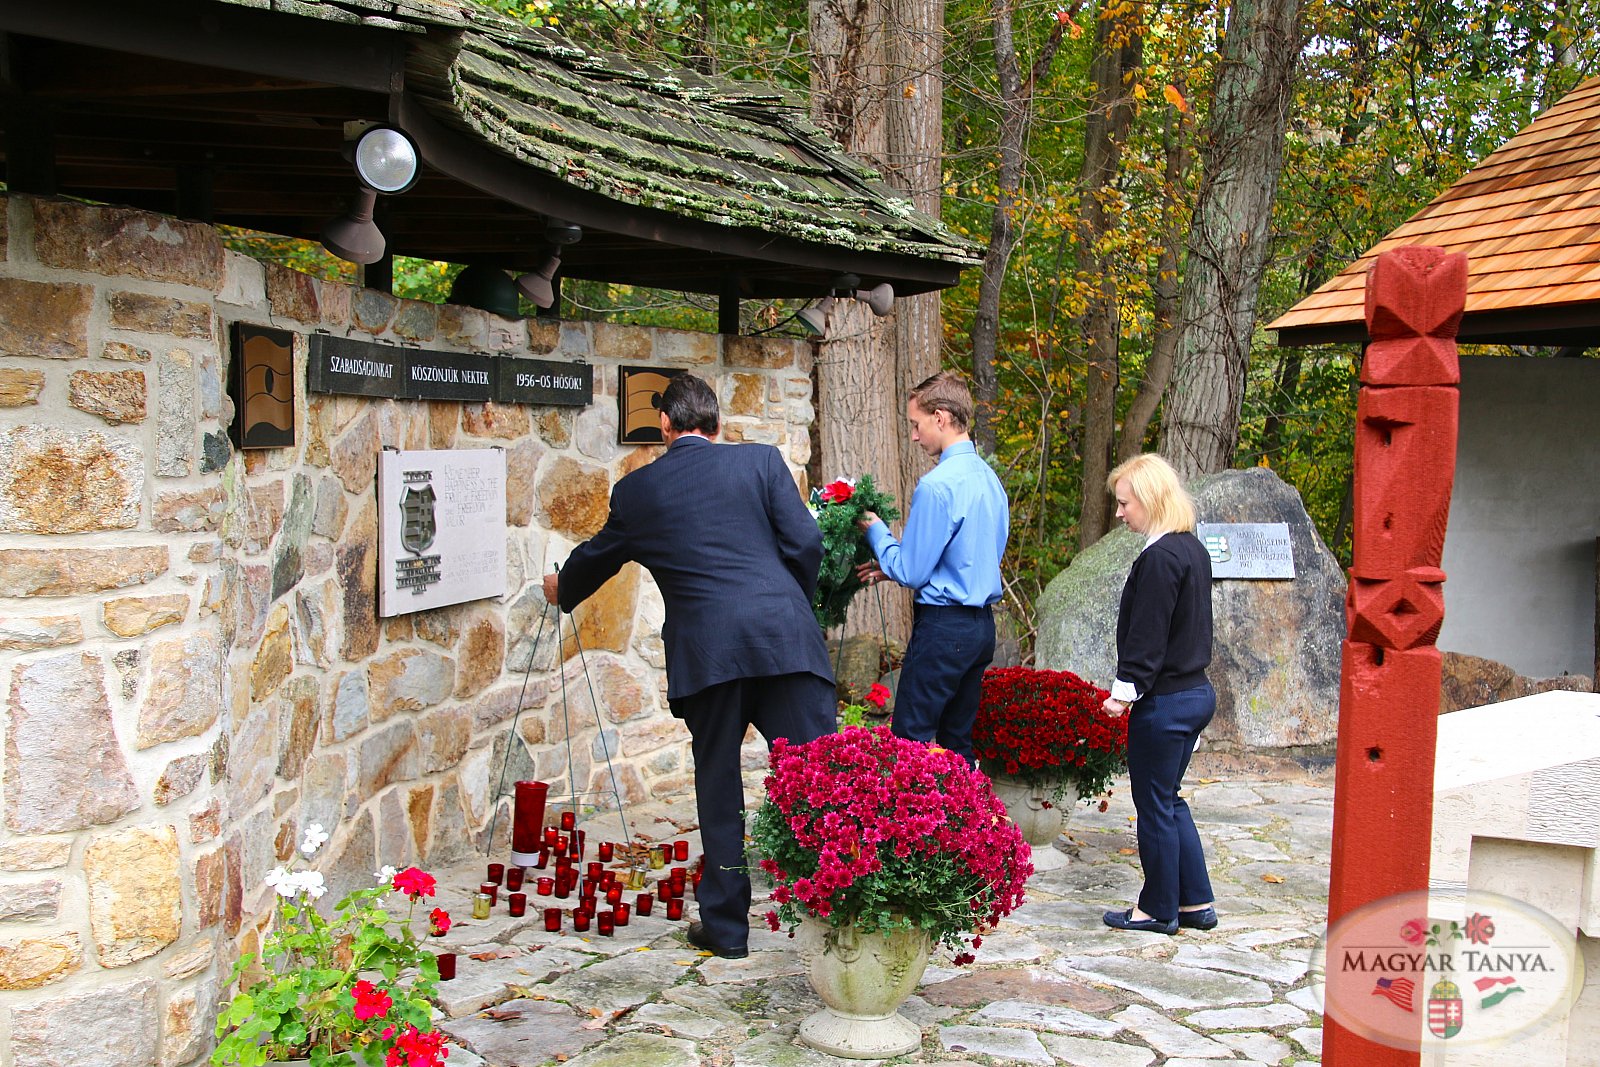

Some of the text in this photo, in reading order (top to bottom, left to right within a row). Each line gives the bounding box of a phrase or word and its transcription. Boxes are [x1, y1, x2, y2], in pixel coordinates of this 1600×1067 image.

[330, 356, 393, 379] SZABADSÁGUNKAT
[411, 364, 489, 385] KÖSZÖNJÜK NEKTEK
[516, 373, 551, 388] 1956-OS
[1236, 531, 1264, 540] MAGYAR
